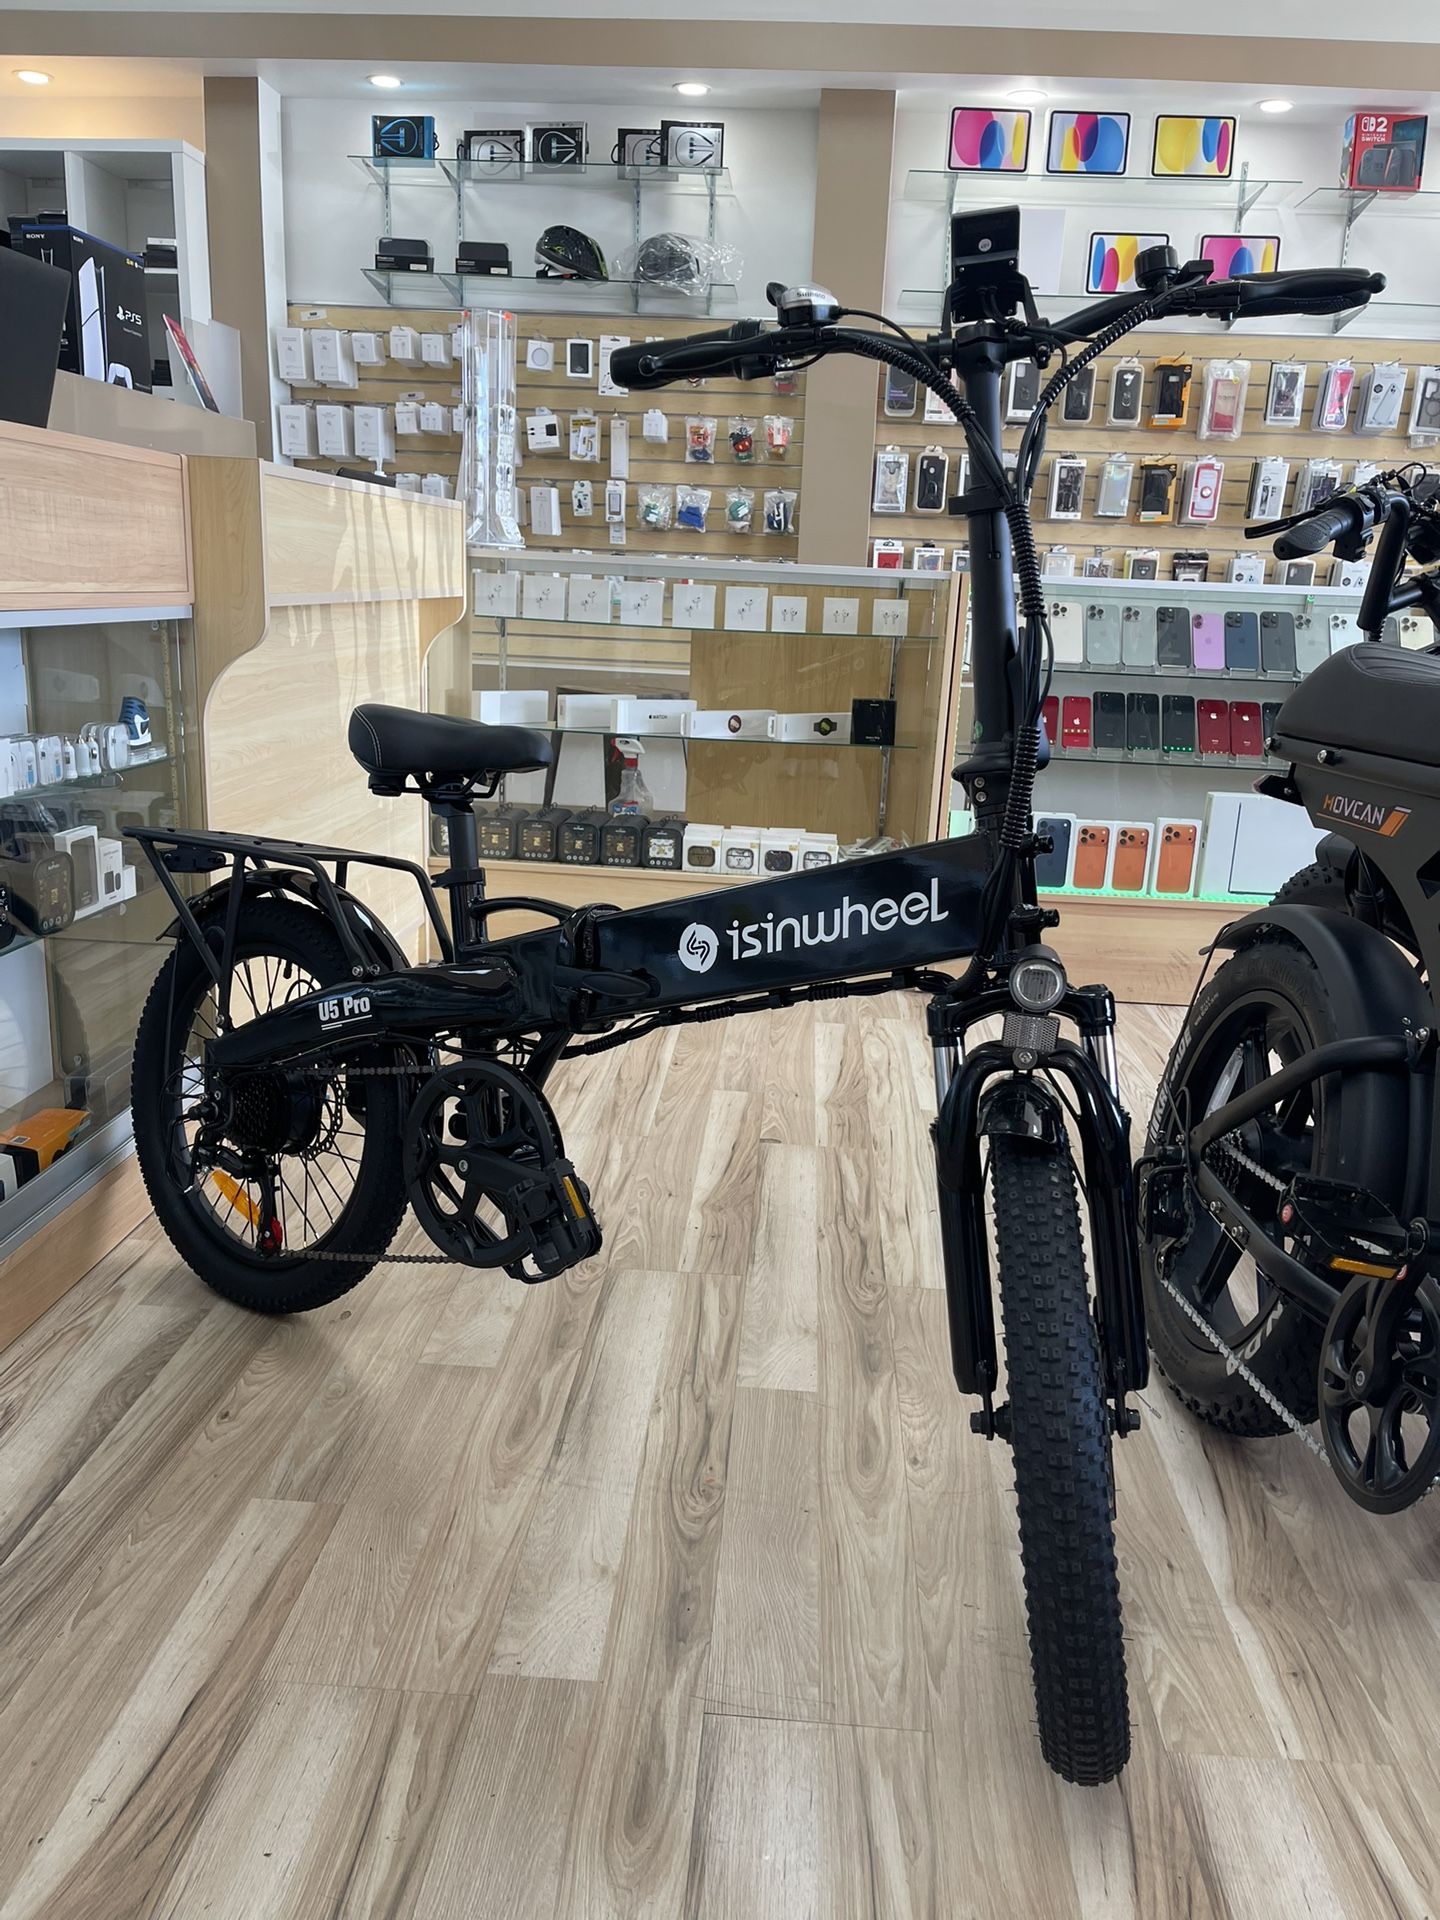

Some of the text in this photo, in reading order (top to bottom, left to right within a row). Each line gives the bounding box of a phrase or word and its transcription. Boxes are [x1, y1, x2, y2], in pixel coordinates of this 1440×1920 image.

[1376, 116, 1387, 132] 2
[125, 310, 142, 326] PS5
[1323, 794, 1385, 826] HOVCAN
[726, 877, 949, 960] isinwheel
[318, 996, 371, 1022] U5 Pro
